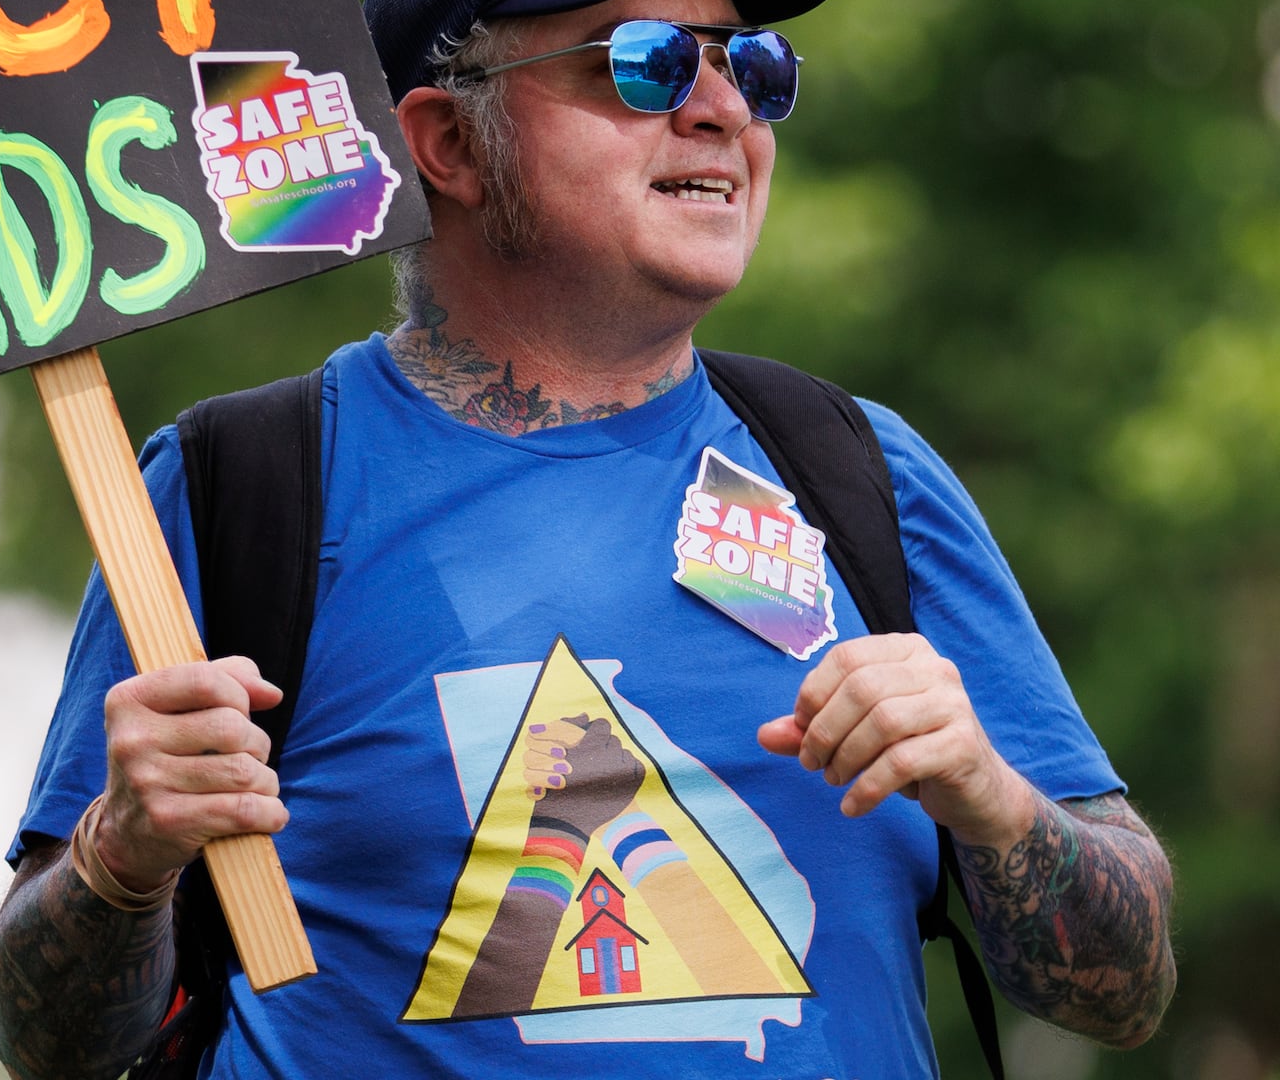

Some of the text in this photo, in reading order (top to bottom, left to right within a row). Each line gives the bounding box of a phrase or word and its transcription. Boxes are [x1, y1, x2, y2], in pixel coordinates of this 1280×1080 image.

[199, 80, 349, 151] SAFE
[207, 128, 365, 199] ZONE
[679, 523, 820, 608] ZONE
[687, 490, 820, 567] SAFE
